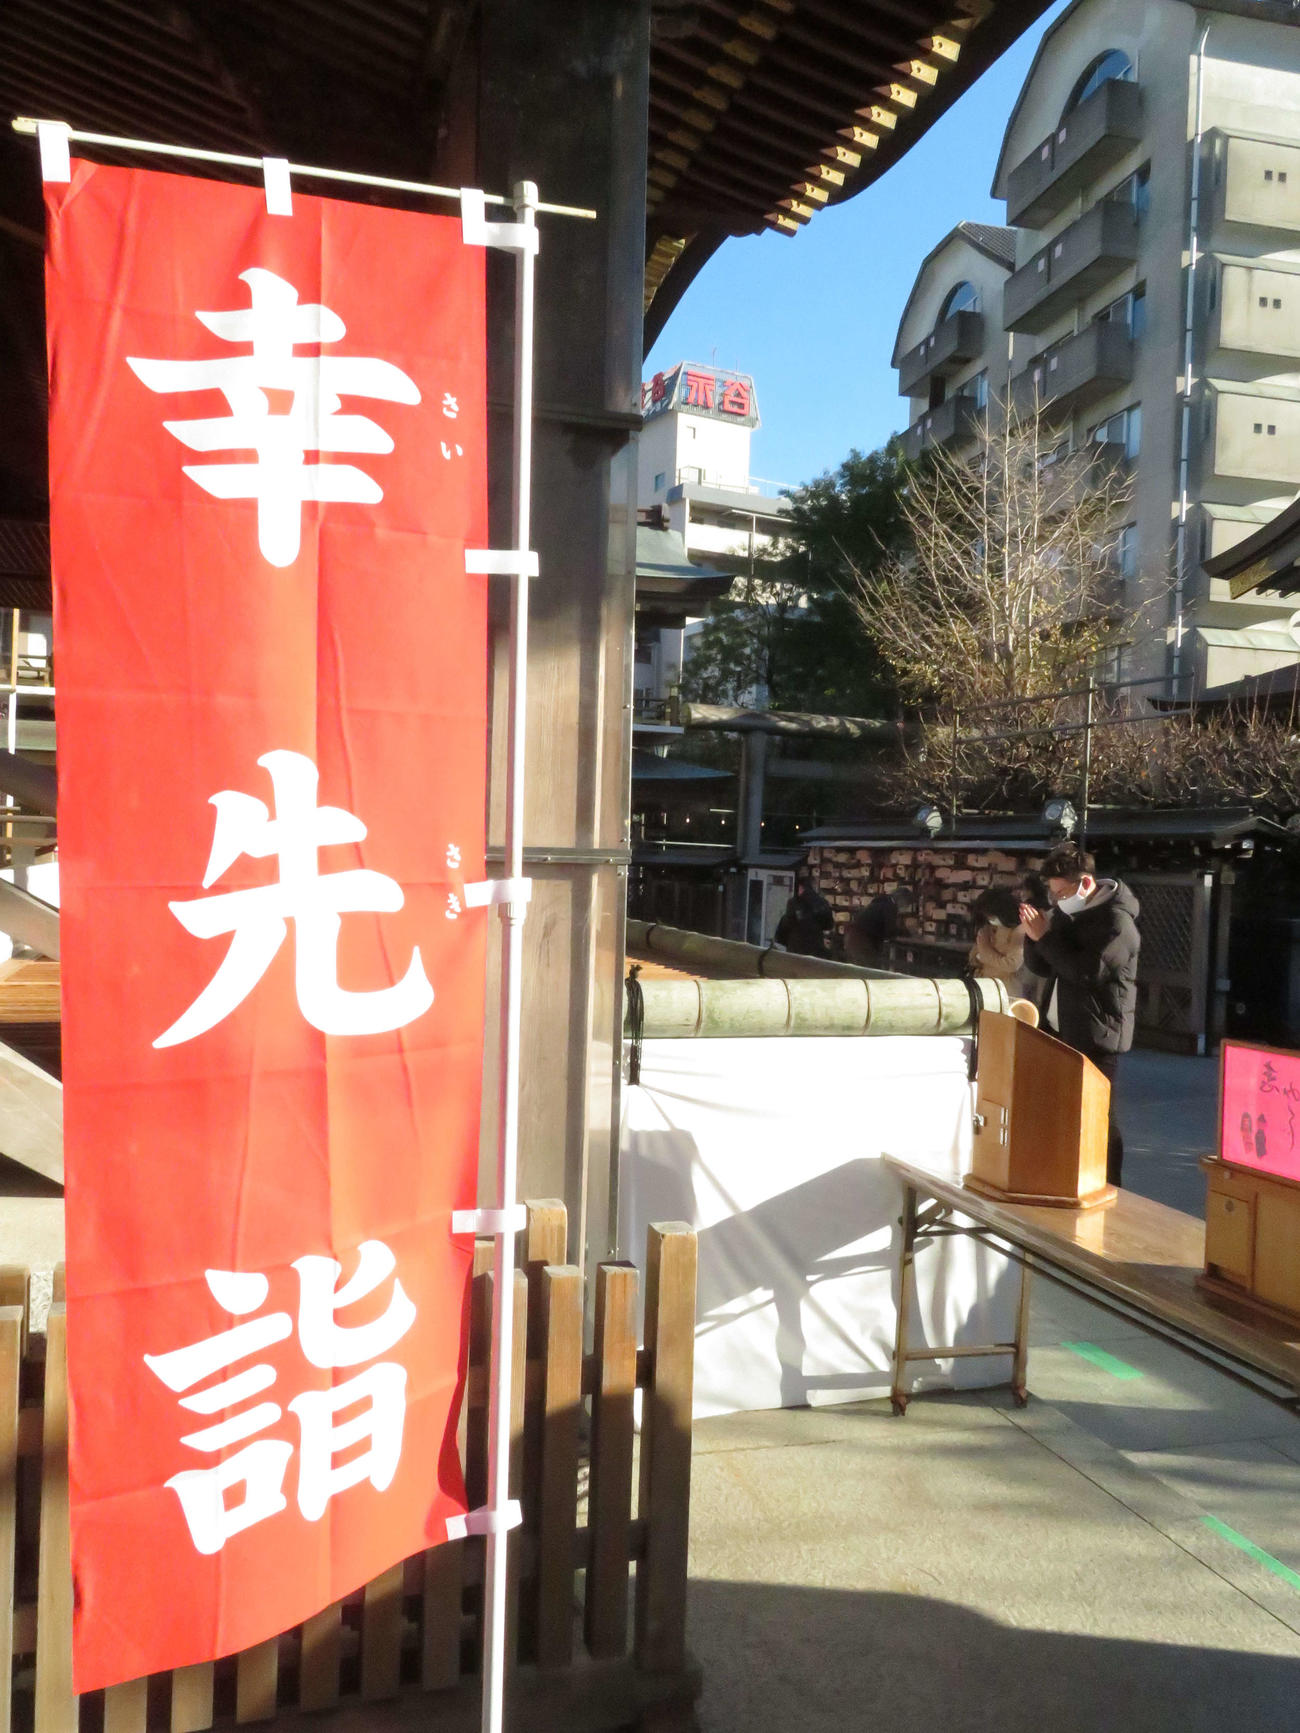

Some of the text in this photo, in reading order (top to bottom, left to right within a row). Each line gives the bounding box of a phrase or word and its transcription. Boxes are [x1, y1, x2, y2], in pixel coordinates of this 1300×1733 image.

[126, 267, 435, 1555] 幸先詣
[440, 392, 463, 919] さい さき
